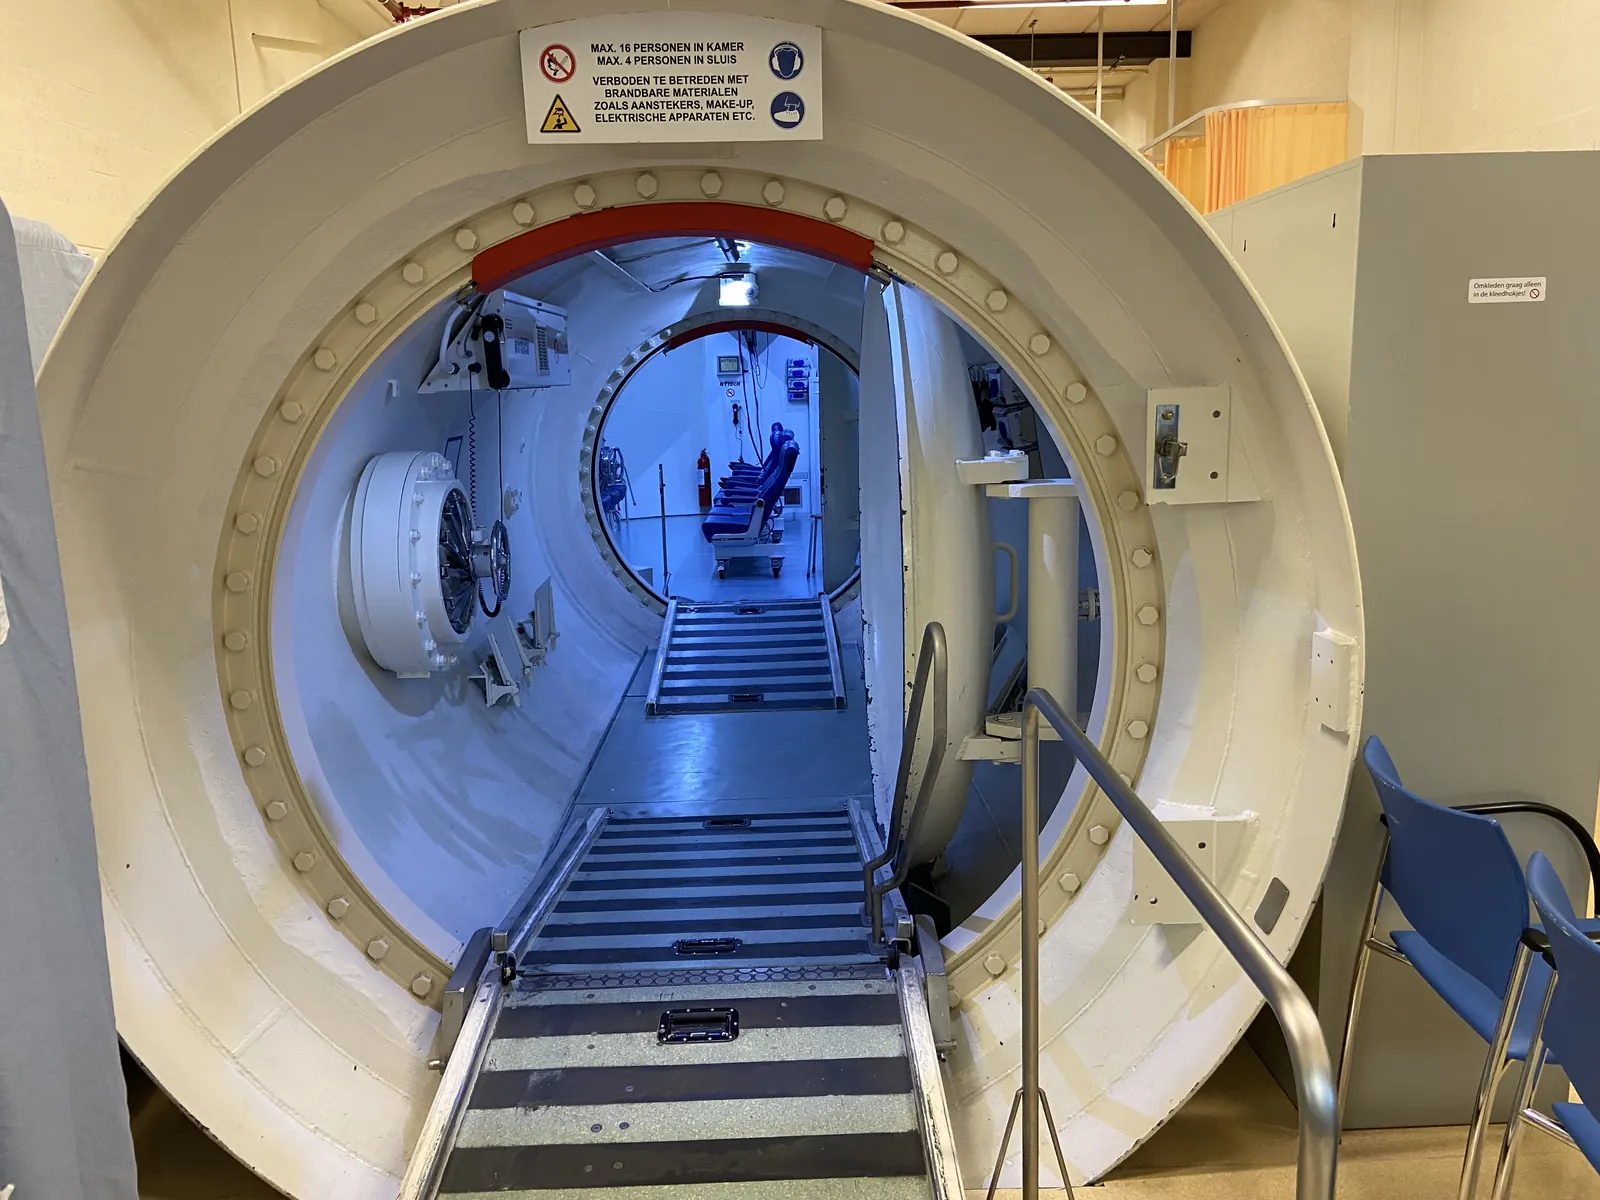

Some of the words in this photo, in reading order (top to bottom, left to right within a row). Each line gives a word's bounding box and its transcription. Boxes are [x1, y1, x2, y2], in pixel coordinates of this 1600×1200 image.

[591, 44, 616, 54] MAX.
[619, 43, 631, 53] 16
[634, 43, 691, 52] PERSONEN
[694, 42, 704, 52] IN
[706, 42, 744, 52] KAMER
[597, 56, 623, 66] MAX.
[625, 56, 632, 65] 4
[634, 55, 692, 65] PERSONEN
[694, 55, 704, 64] IN
[707, 54, 736, 64] SLUIS
[592, 76, 650, 86] VERBODEN
[653, 76, 666, 85] TE
[669, 75, 725, 85] BETREDEN
[728, 75, 749, 84] MET
[605, 88, 670, 98] BRANDBARE
[673, 88, 738, 97] MATERIALEN
[594, 101, 628, 111] ZOALS
[631, 100, 703, 111] AANSTEKERS,
[706, 99, 754, 110] MAKE-UP,
[595, 113, 666, 122] ELEKTRISCHE
[668, 112, 730, 121] APPARATEN
[732, 111, 755, 121] ETC.
